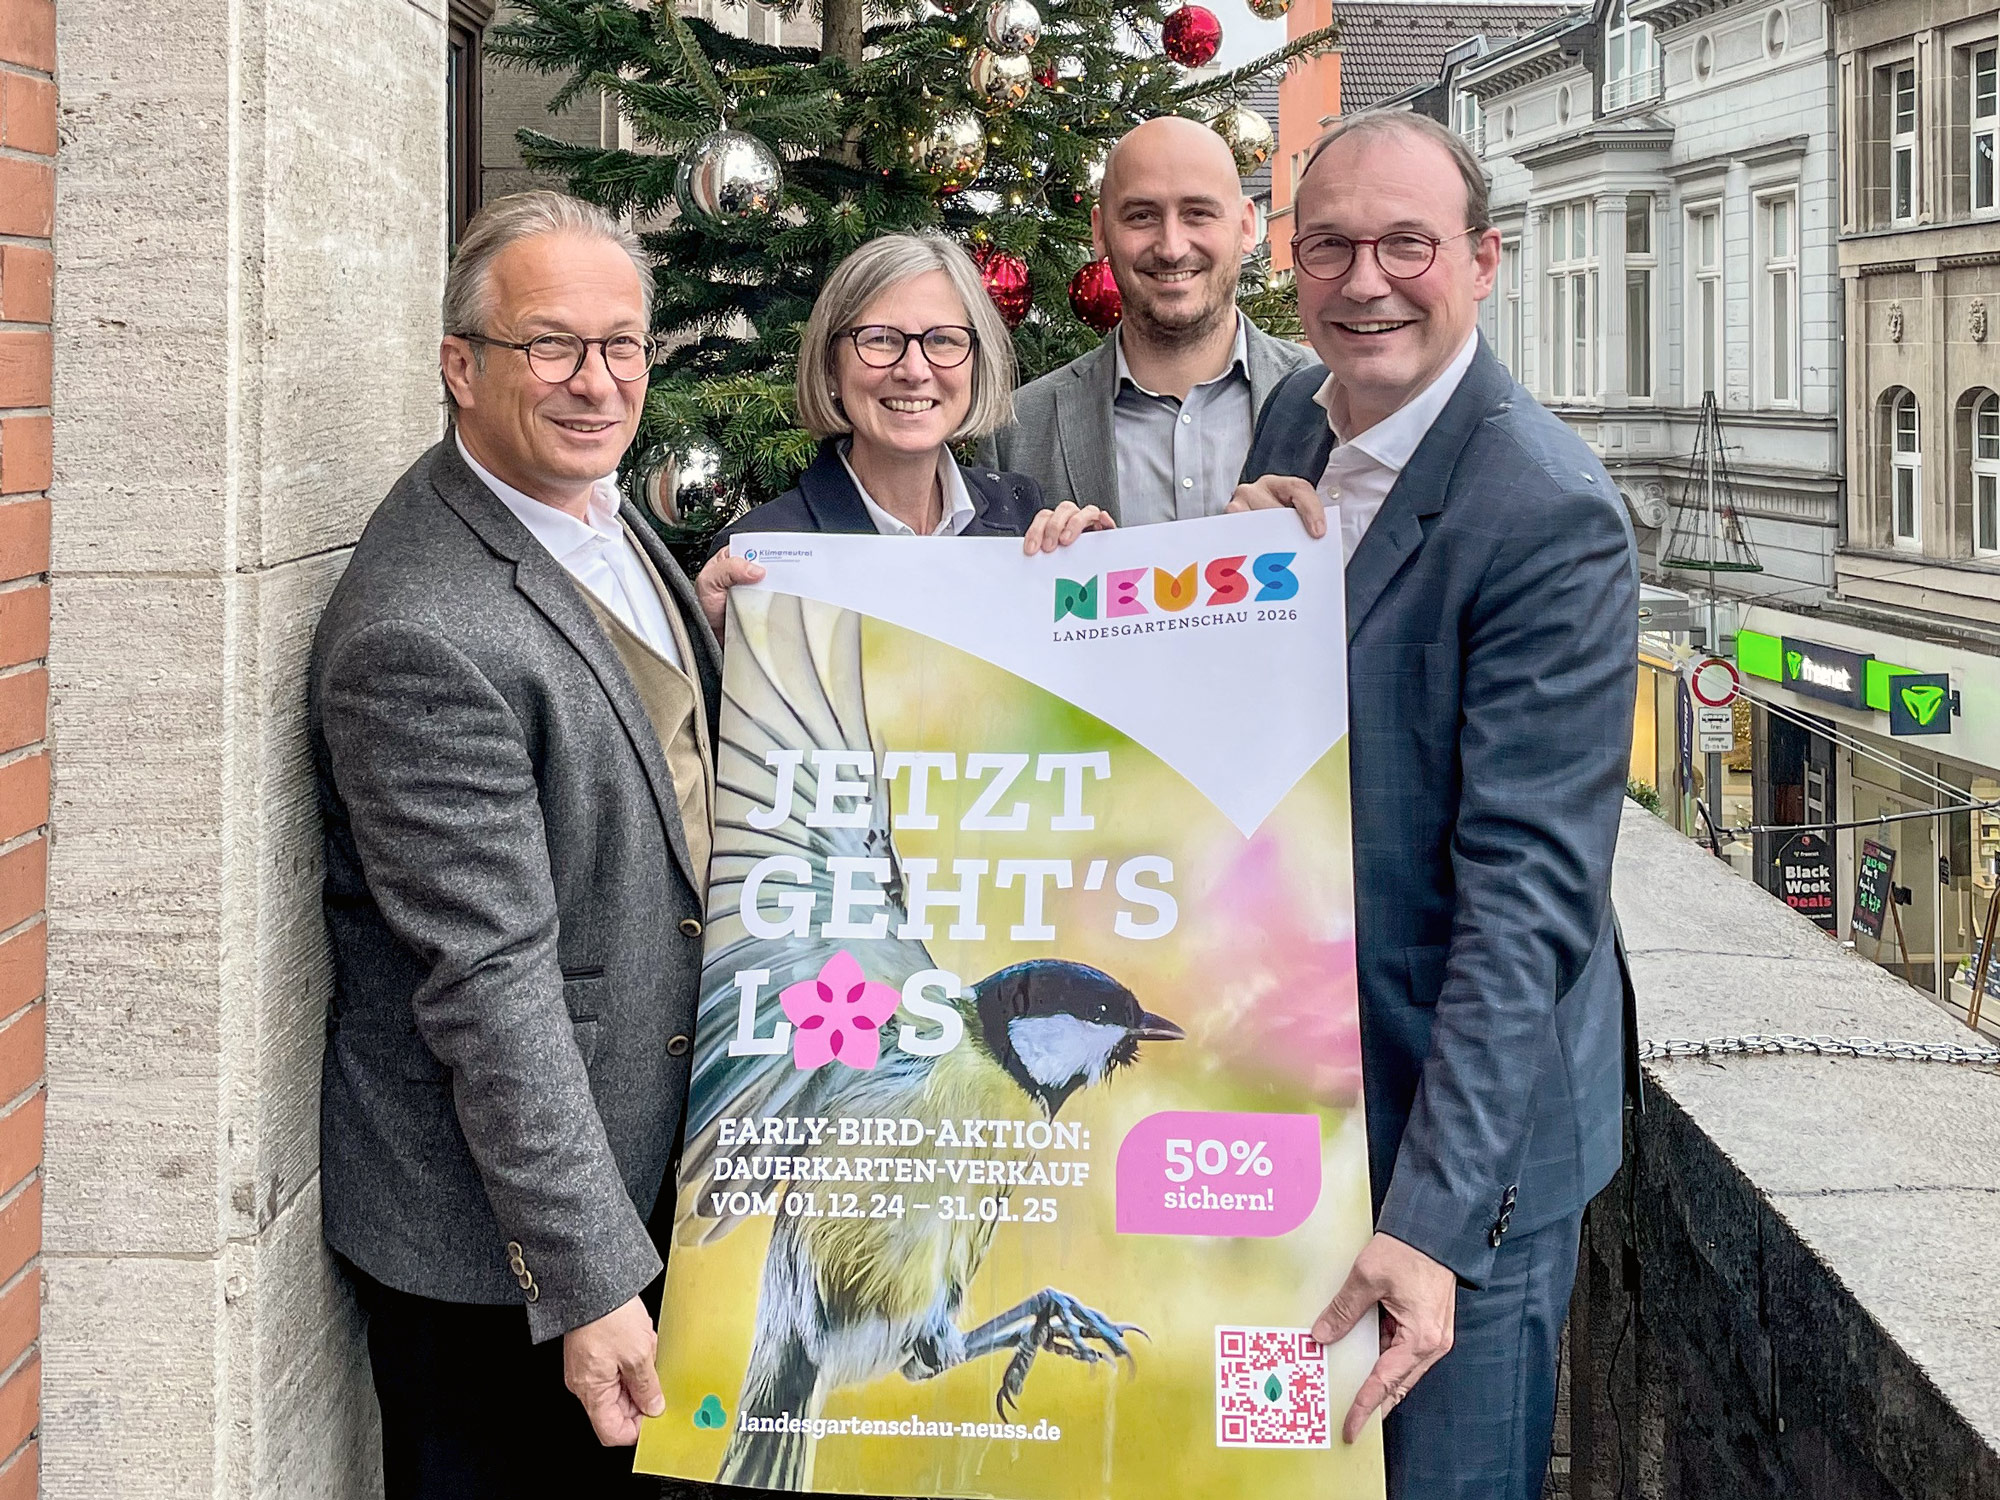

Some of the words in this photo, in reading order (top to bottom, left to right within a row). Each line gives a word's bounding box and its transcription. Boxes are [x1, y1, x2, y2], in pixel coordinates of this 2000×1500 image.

[1053, 551, 1300, 624] NEUSS
[1052, 611, 1249, 643] LANDESGARTENSCHAU
[1256, 608, 1298, 622] 2026
[745, 749, 1111, 832] JETZT
[1785, 864, 1830, 879] Black
[1785, 880, 1831, 894] Week
[739, 855, 1179, 941] GEHT'S
[1786, 895, 1833, 908] Deals
[716, 1117, 1091, 1151] EARLY-BIRD-AKTION:
[712, 1156, 1090, 1187] DAUERKARTEN-VERKAUF
[1164, 1138, 1273, 1183] 50%
[710, 1192, 779, 1217] VOM
[784, 1192, 906, 1219] 01.12.24
[937, 1195, 1058, 1223] 31.01.25
[1164, 1185, 1274, 1212] sichern!
[739, 1411, 1061, 1441] landesgartenschau-neuss.de
